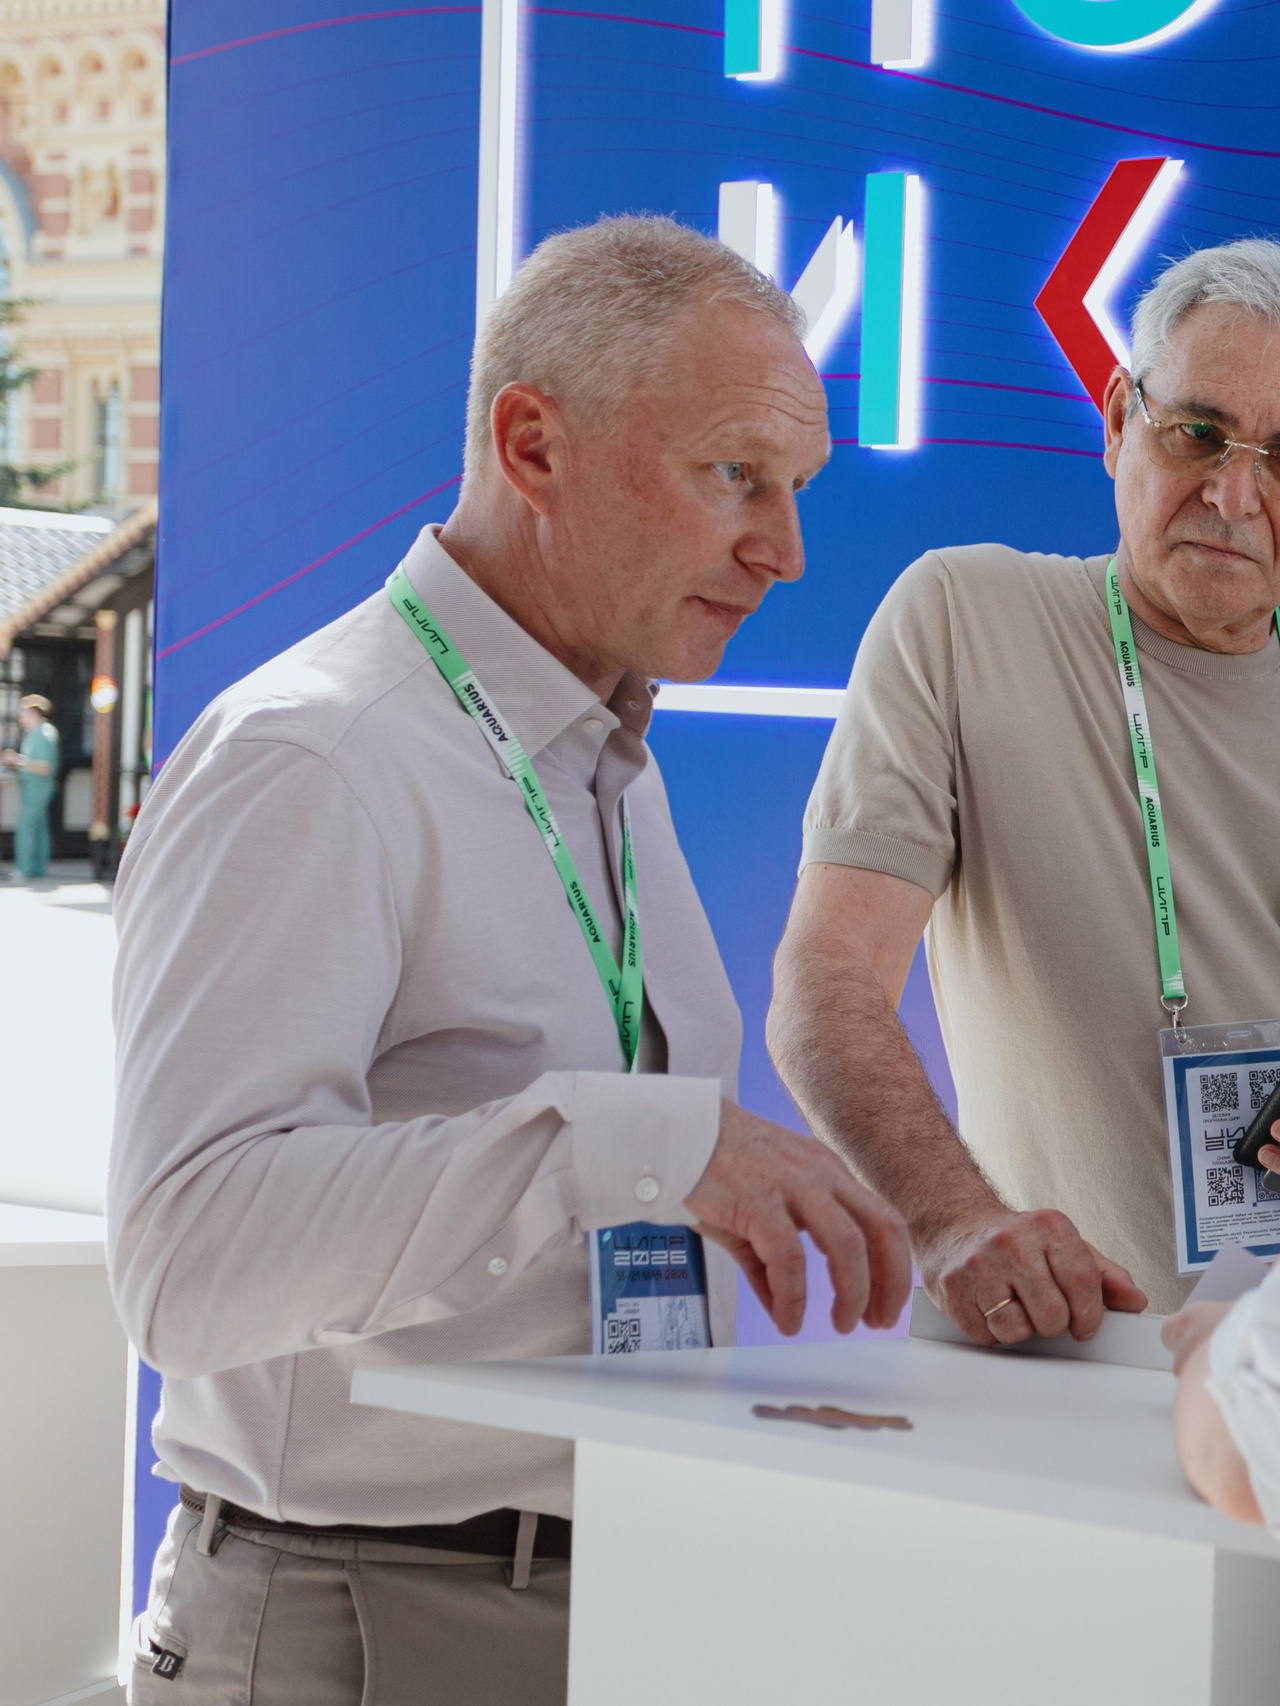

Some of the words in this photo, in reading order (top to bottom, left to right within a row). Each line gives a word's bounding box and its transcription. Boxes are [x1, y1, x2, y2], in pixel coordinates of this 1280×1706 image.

[1119, 640, 1135, 688] AQUARIUS
[463, 682, 509, 743] AQUARIUS
[1145, 797, 1161, 848] AQUARIUS
[569, 881, 602, 944] AQUARIUS
[627, 909, 637, 968] AQUARIUS
[614, 1250, 687, 1266] 2026
[158, 1655, 175, 1672] B
